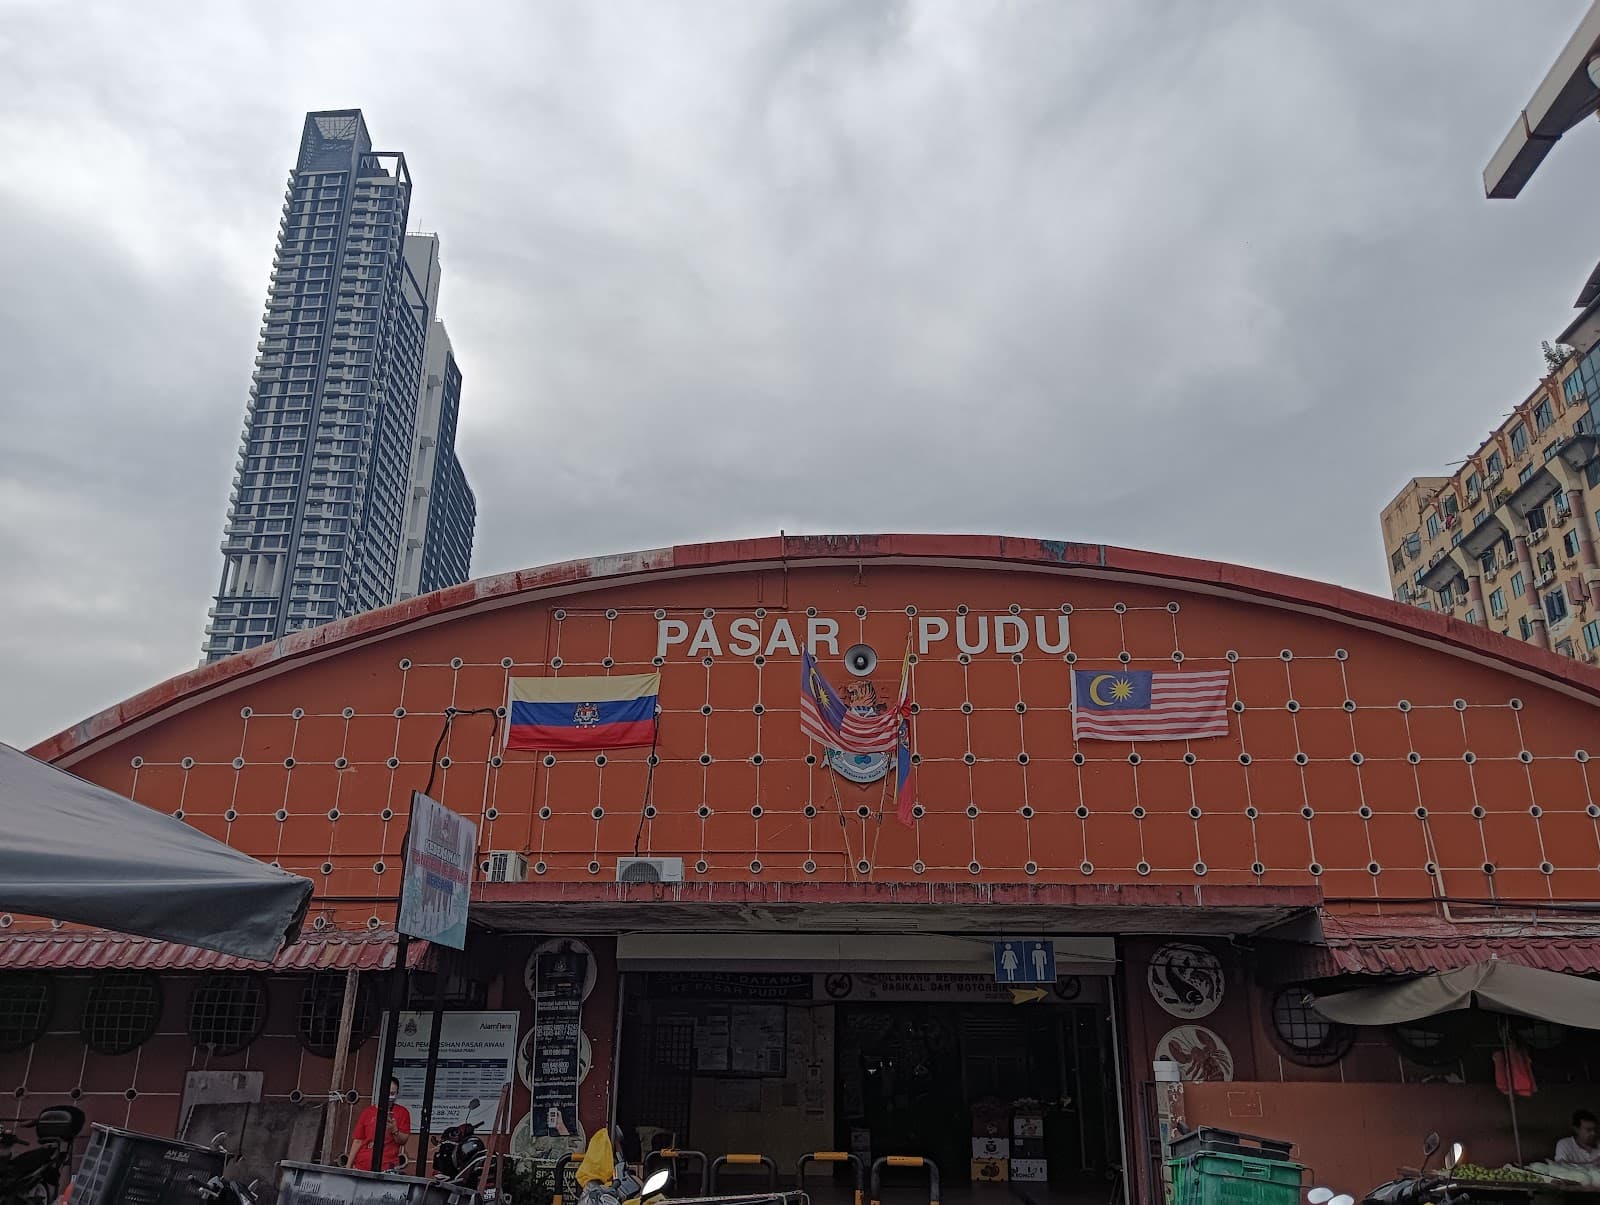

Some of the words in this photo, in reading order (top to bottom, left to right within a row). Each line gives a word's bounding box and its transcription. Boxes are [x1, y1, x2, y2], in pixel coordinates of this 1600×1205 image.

[658, 617, 840, 657] PASAR
[918, 615, 1071, 655] PUDU
[750, 987, 788, 998] PUDU
[881, 983, 926, 993] BASIKAL
